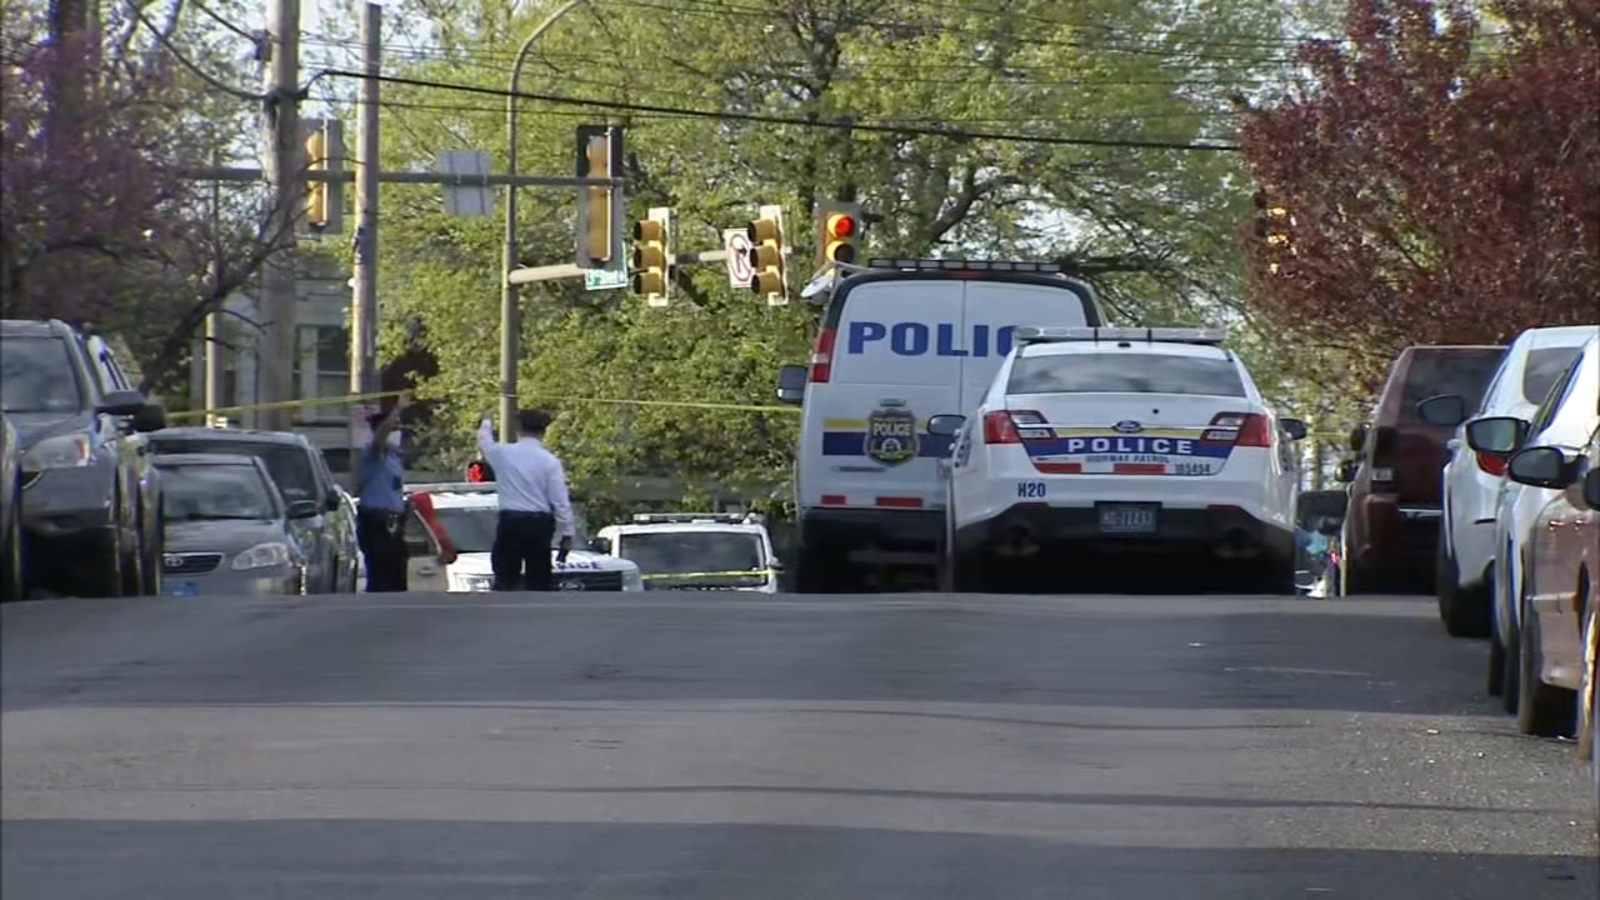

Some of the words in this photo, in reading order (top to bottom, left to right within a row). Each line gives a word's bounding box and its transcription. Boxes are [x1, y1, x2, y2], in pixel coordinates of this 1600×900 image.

[873, 422, 911, 436] POLICE
[1067, 438, 1193, 455] POLICE
[1017, 482, 1047, 498] H20
